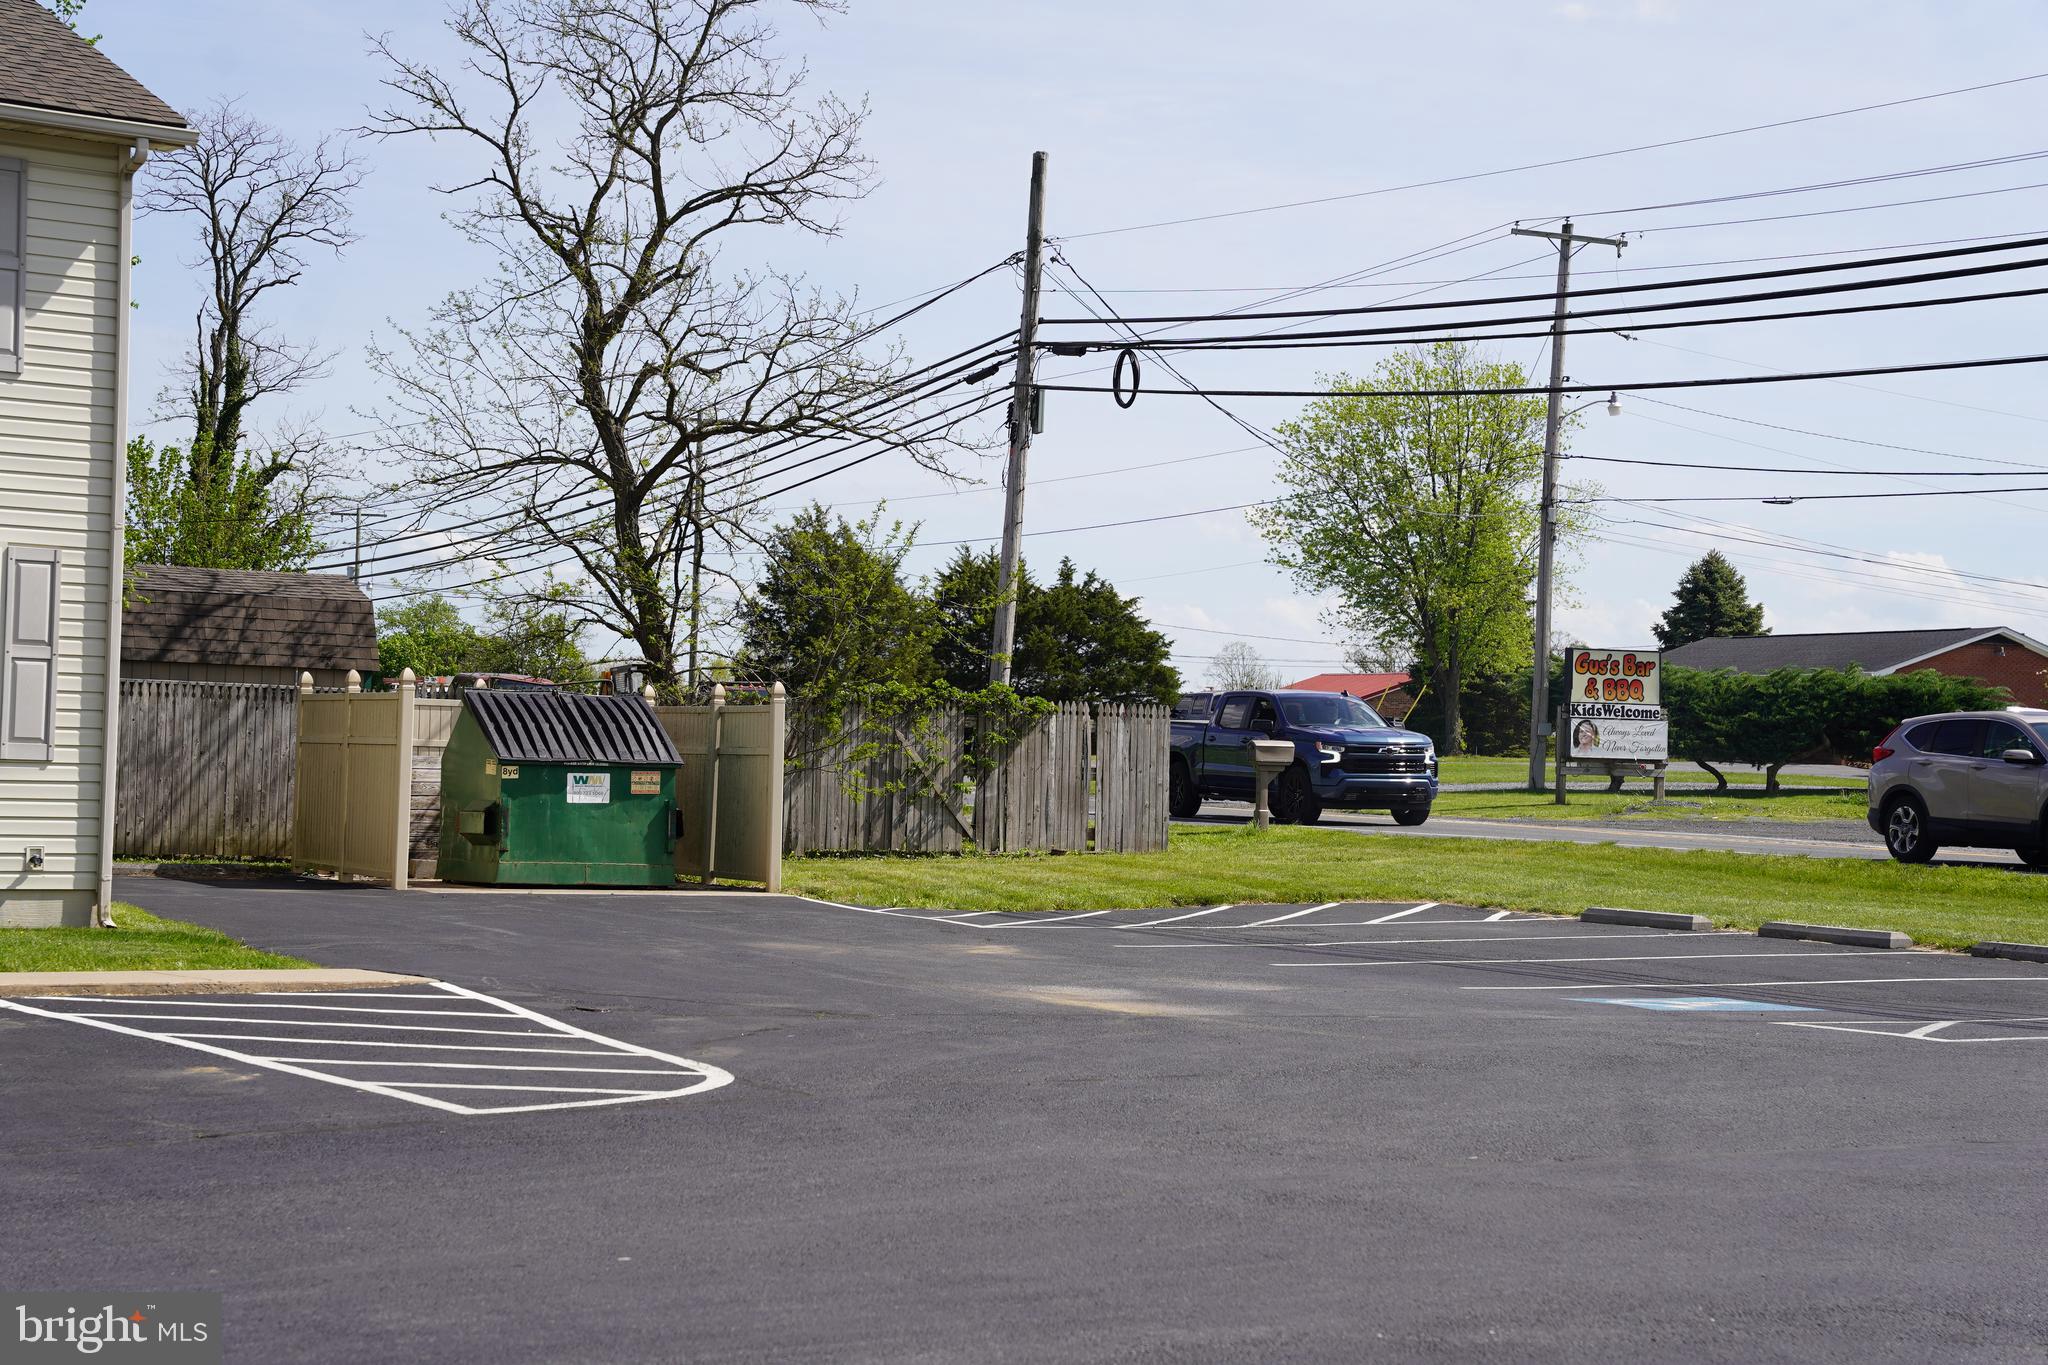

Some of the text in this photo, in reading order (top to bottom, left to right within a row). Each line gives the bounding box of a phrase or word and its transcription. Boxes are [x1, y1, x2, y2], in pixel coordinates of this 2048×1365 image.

[1575, 652, 1656, 677] Gus's Bar
[1585, 677, 1644, 702] & BBQ
[1602, 725, 1656, 739] Always Loved
[1602, 740, 1666, 755] Never Forgotten
[502, 767, 519, 776] 8yd
